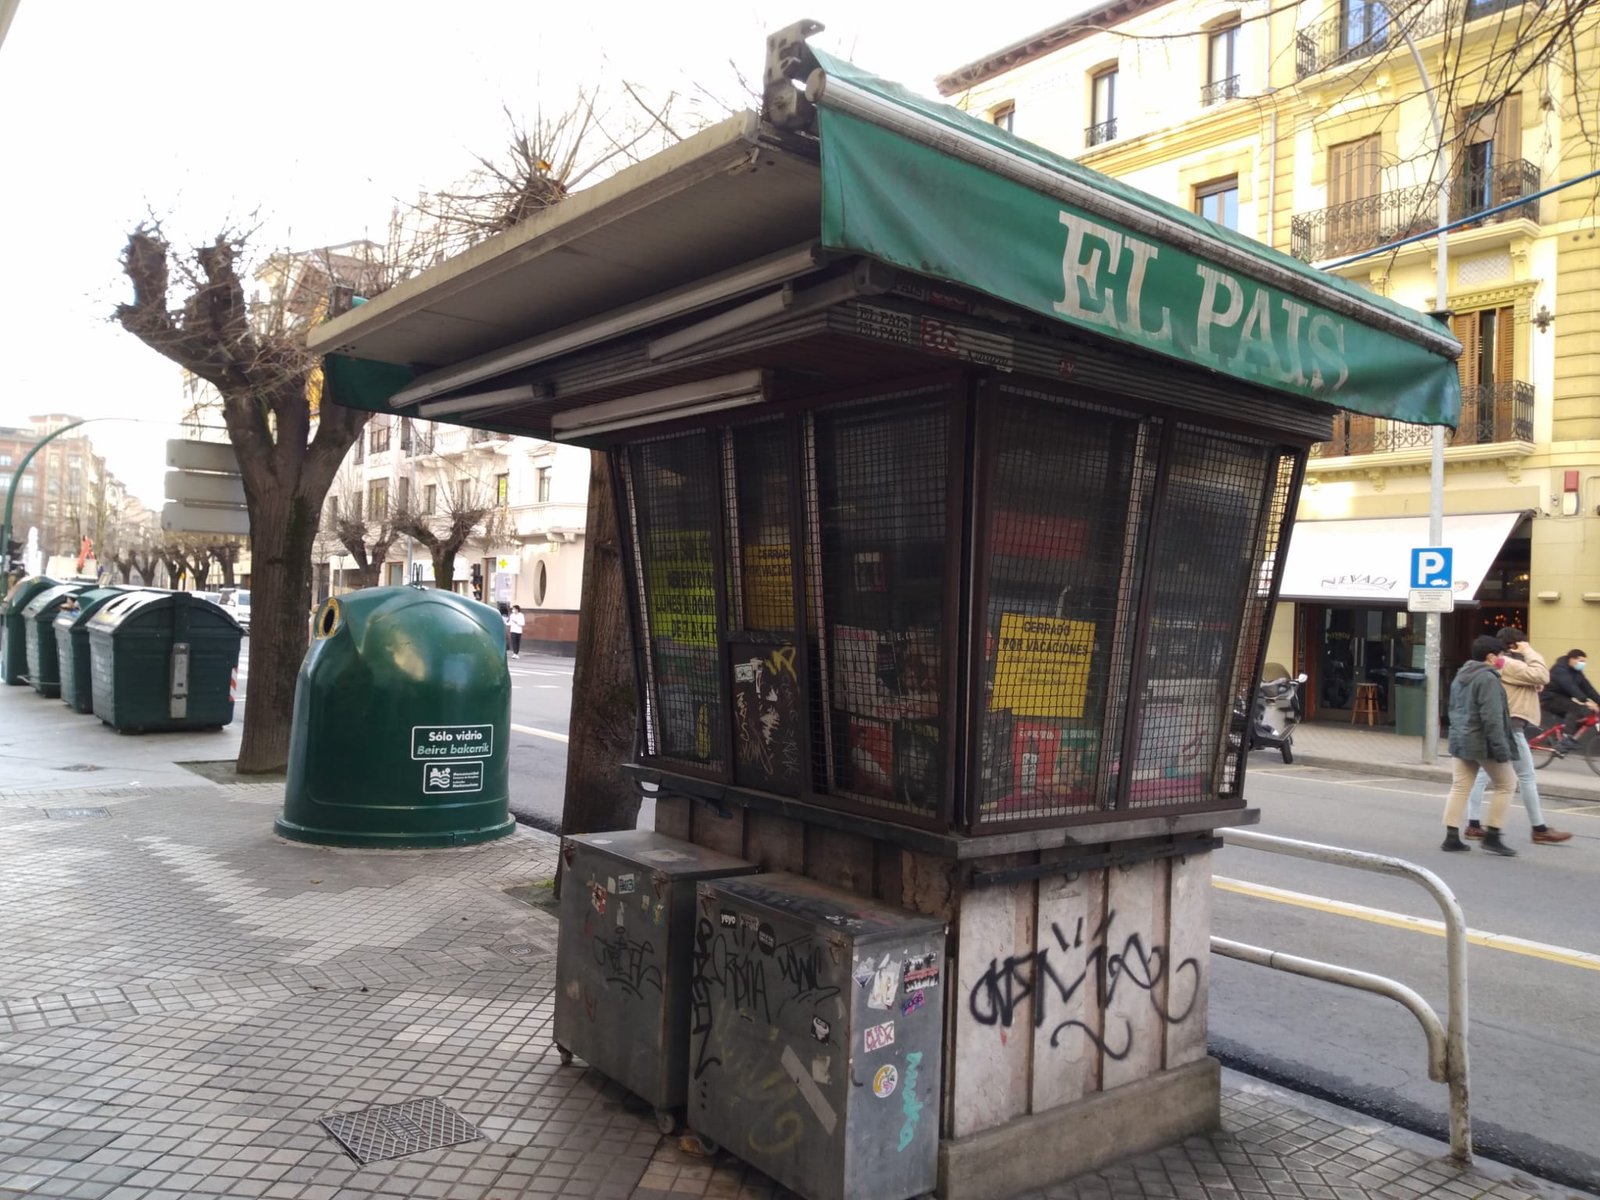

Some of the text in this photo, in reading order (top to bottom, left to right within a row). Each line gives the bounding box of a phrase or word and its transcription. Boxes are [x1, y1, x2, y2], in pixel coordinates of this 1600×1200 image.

[1053, 210, 1349, 391] EL PAIS
[1418, 551, 1445, 585] P
[1320, 574, 1397, 589] NEVADA
[1023, 621, 1071, 637] CERRADO
[1003, 638, 1088, 656] POR VACACIONES
[428, 730, 483, 742] Sólo vidrio
[417, 742, 489, 755] Beira bakarrik
